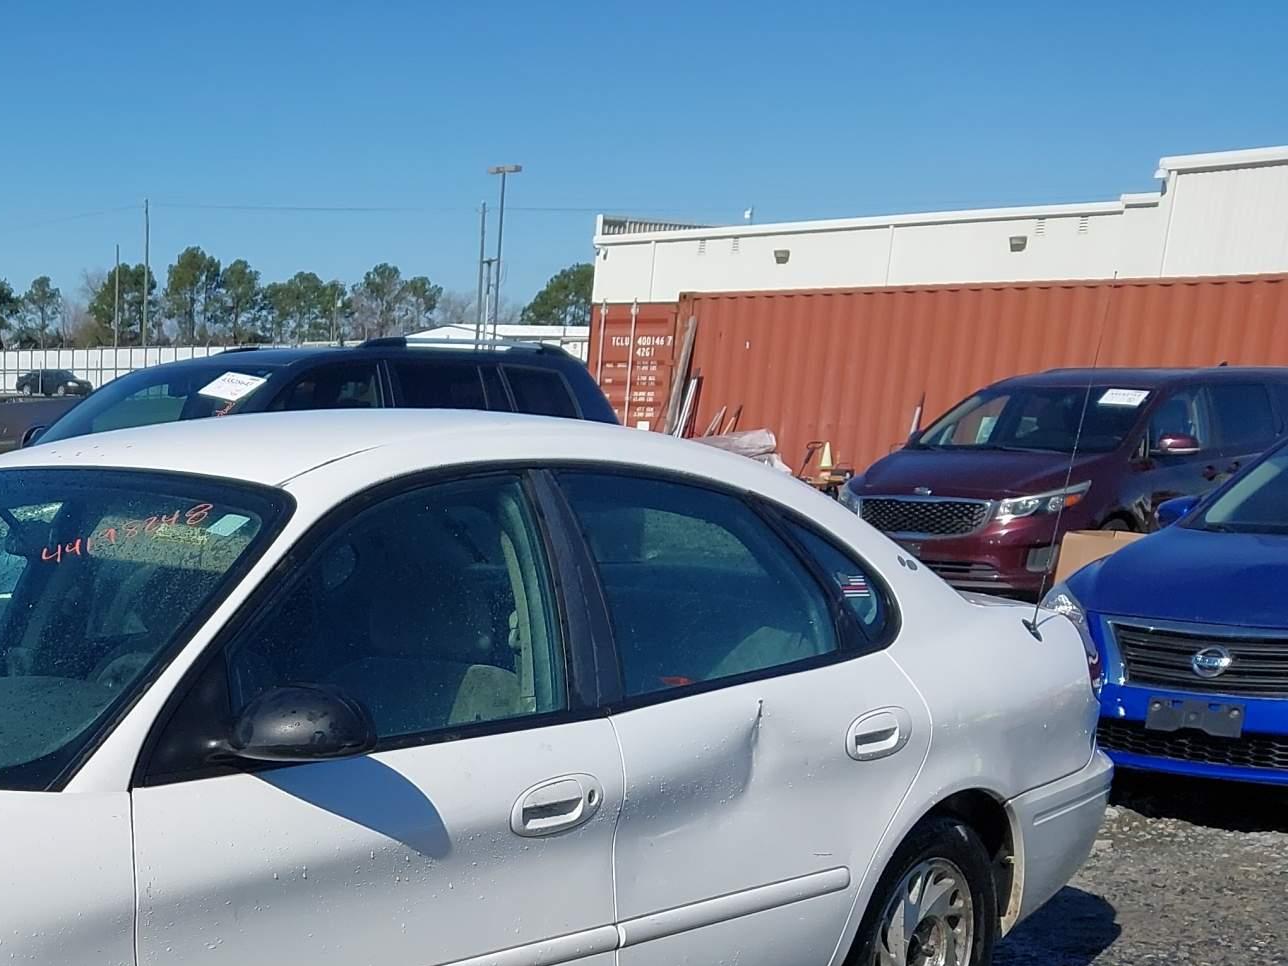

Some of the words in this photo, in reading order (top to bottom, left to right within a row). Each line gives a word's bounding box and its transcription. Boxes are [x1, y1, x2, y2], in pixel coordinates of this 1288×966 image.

[612, 336, 630, 346] TCLU
[637, 336, 665, 346] 400146
[666, 335, 673, 346] 7
[41, 503, 214, 563] 44198248
